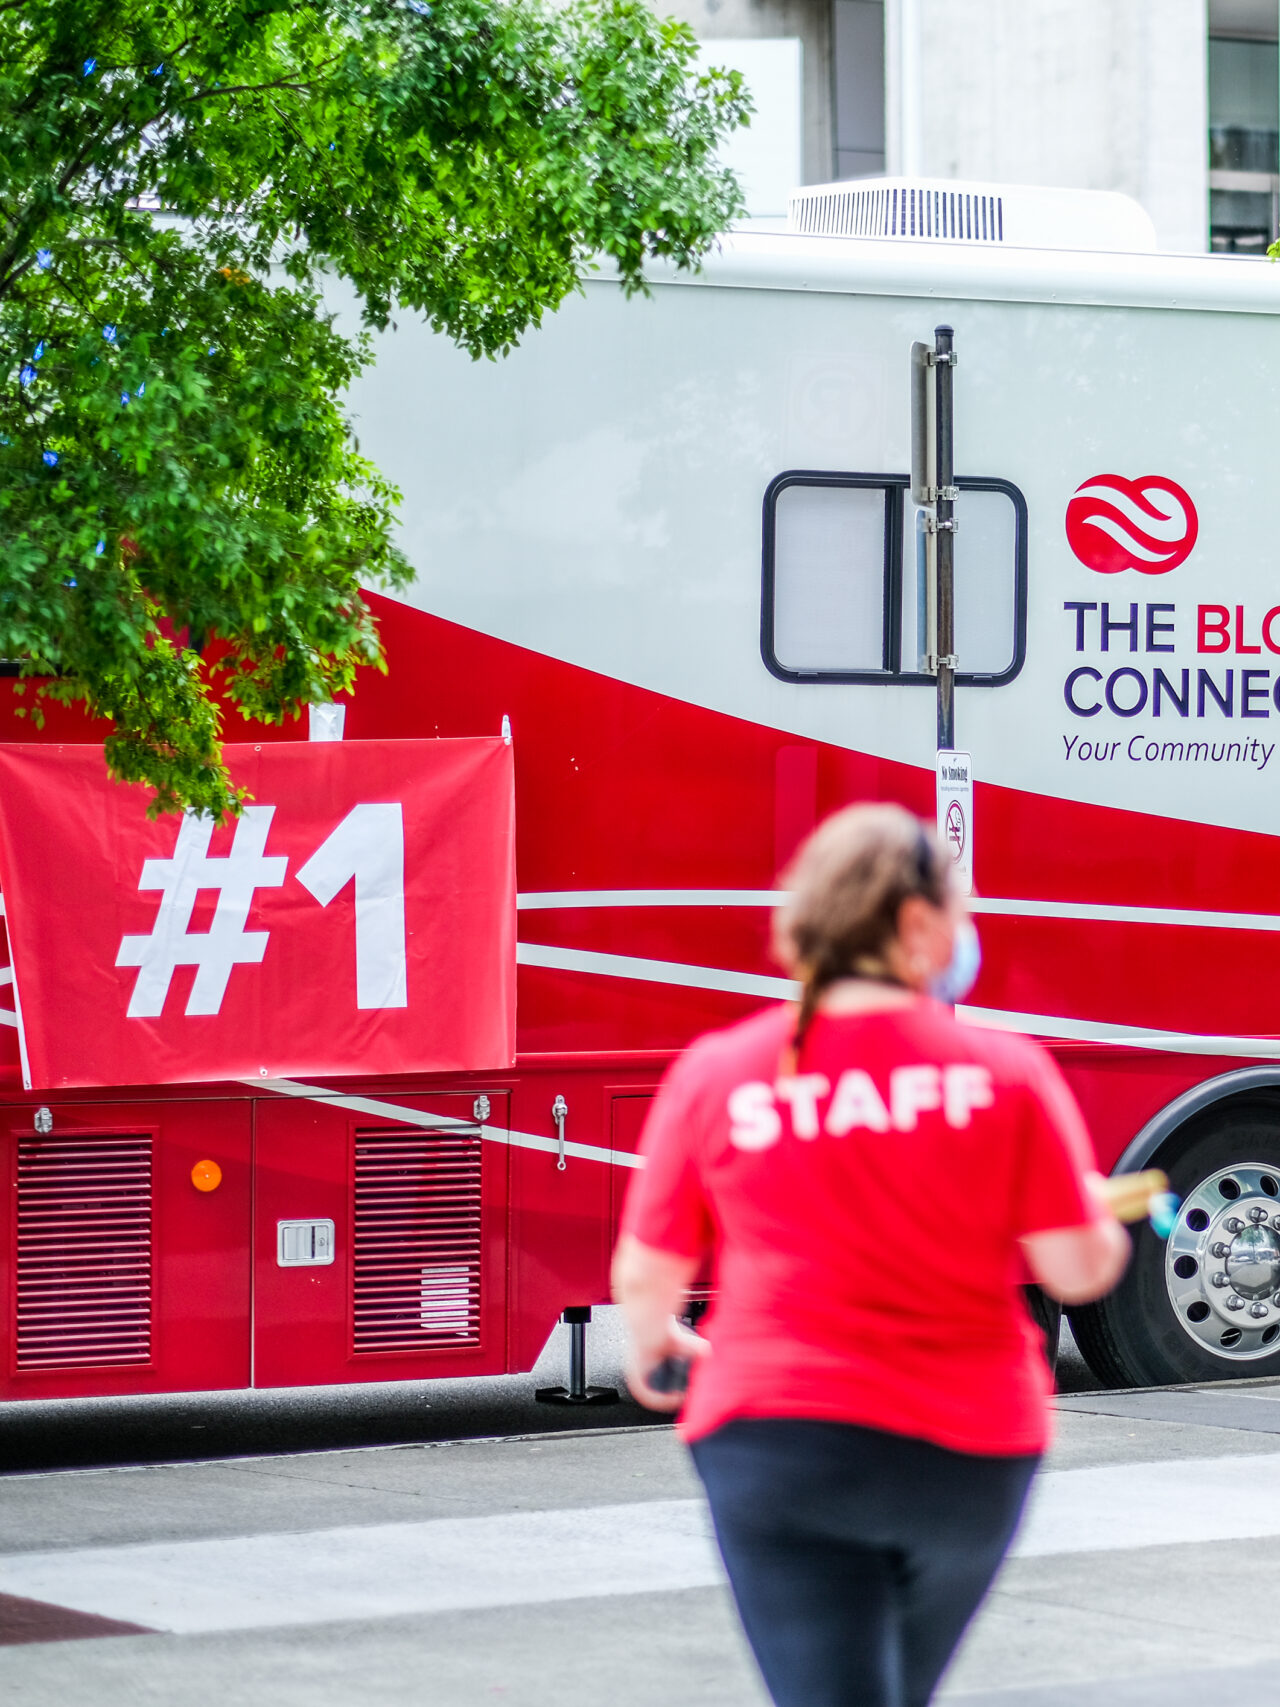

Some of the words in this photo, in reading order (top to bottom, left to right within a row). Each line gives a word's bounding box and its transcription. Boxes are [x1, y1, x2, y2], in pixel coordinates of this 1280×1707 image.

[1063, 602, 1175, 653] THE
[1063, 735, 1121, 761] Your
[1127, 735, 1275, 770] Community
[114, 803, 408, 1018] #1
[727, 1063, 995, 1153] STAFF
